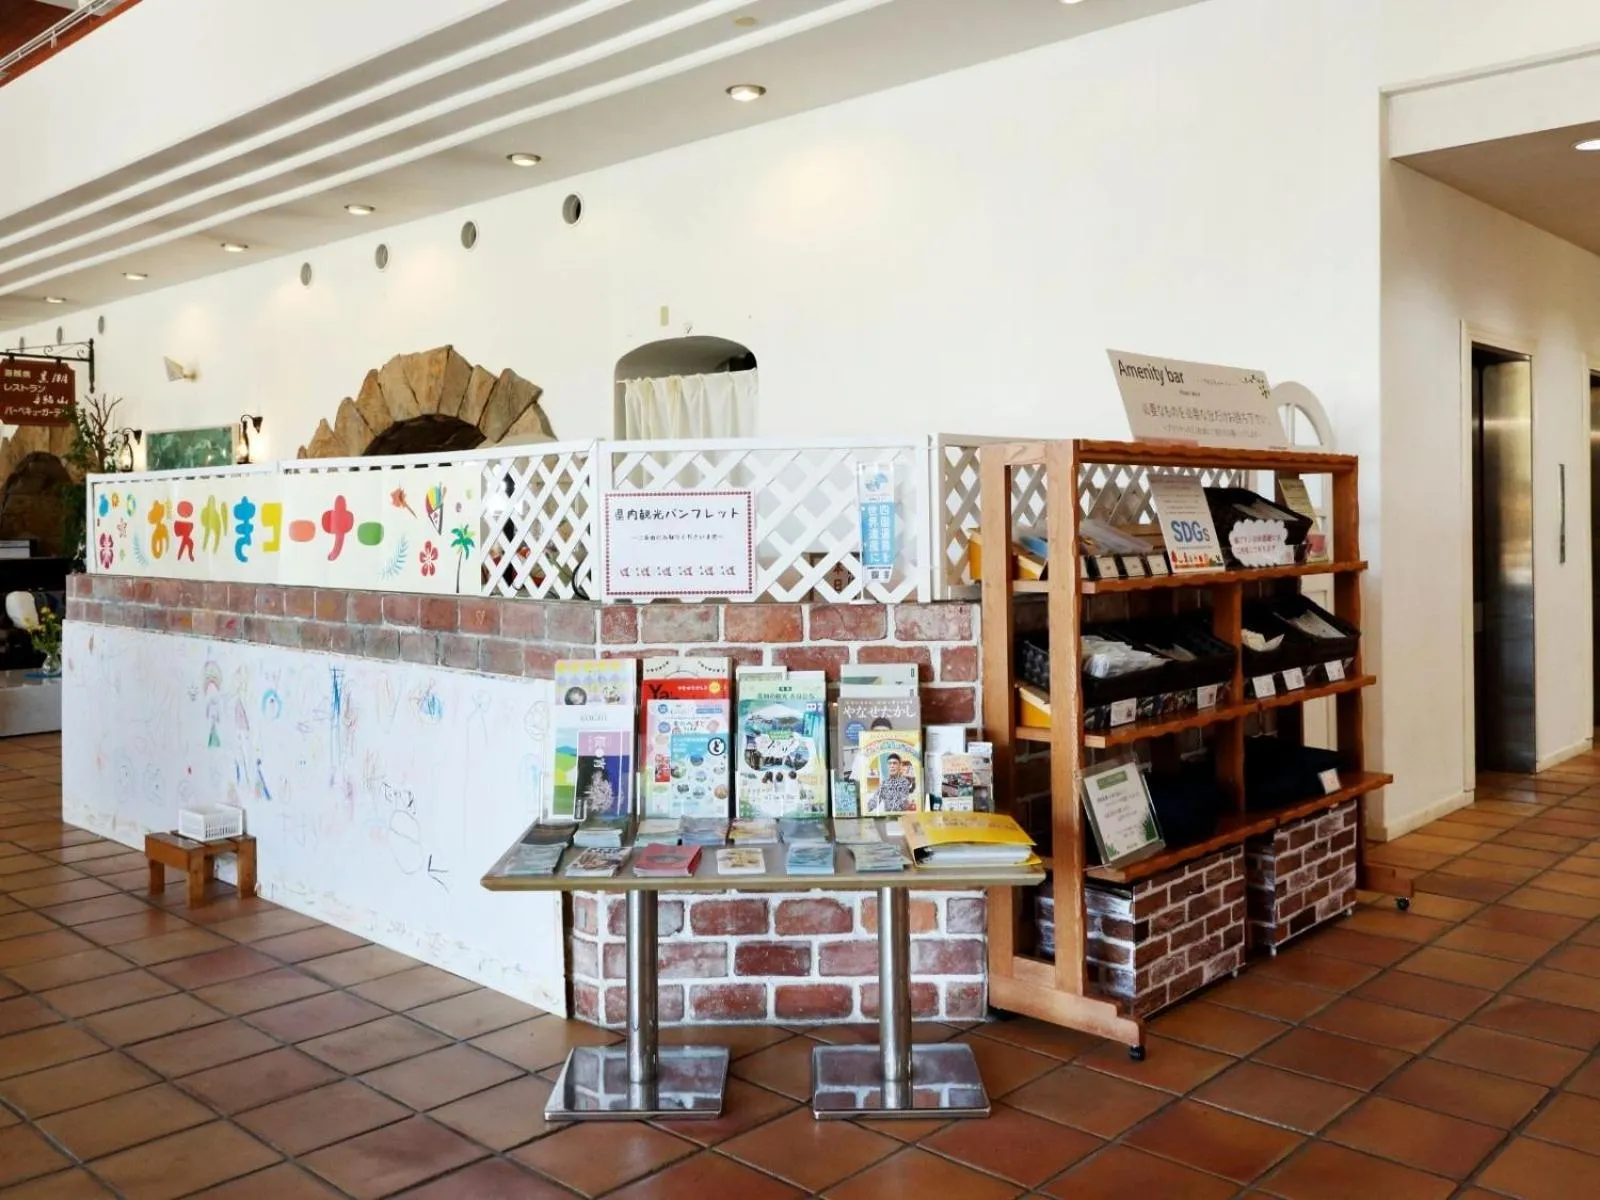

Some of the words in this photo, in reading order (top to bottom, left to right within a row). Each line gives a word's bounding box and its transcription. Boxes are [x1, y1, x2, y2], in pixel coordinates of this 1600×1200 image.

[1118, 359, 1165, 387] Amenity
[1165, 366, 1185, 385] bar
[4, 383, 46, 393] レストラン
[614, 507, 740, 521] 県内観光パンフレット
[1171, 519, 1211, 543] SDGs
[843, 705, 917, 719] やなせたかし
